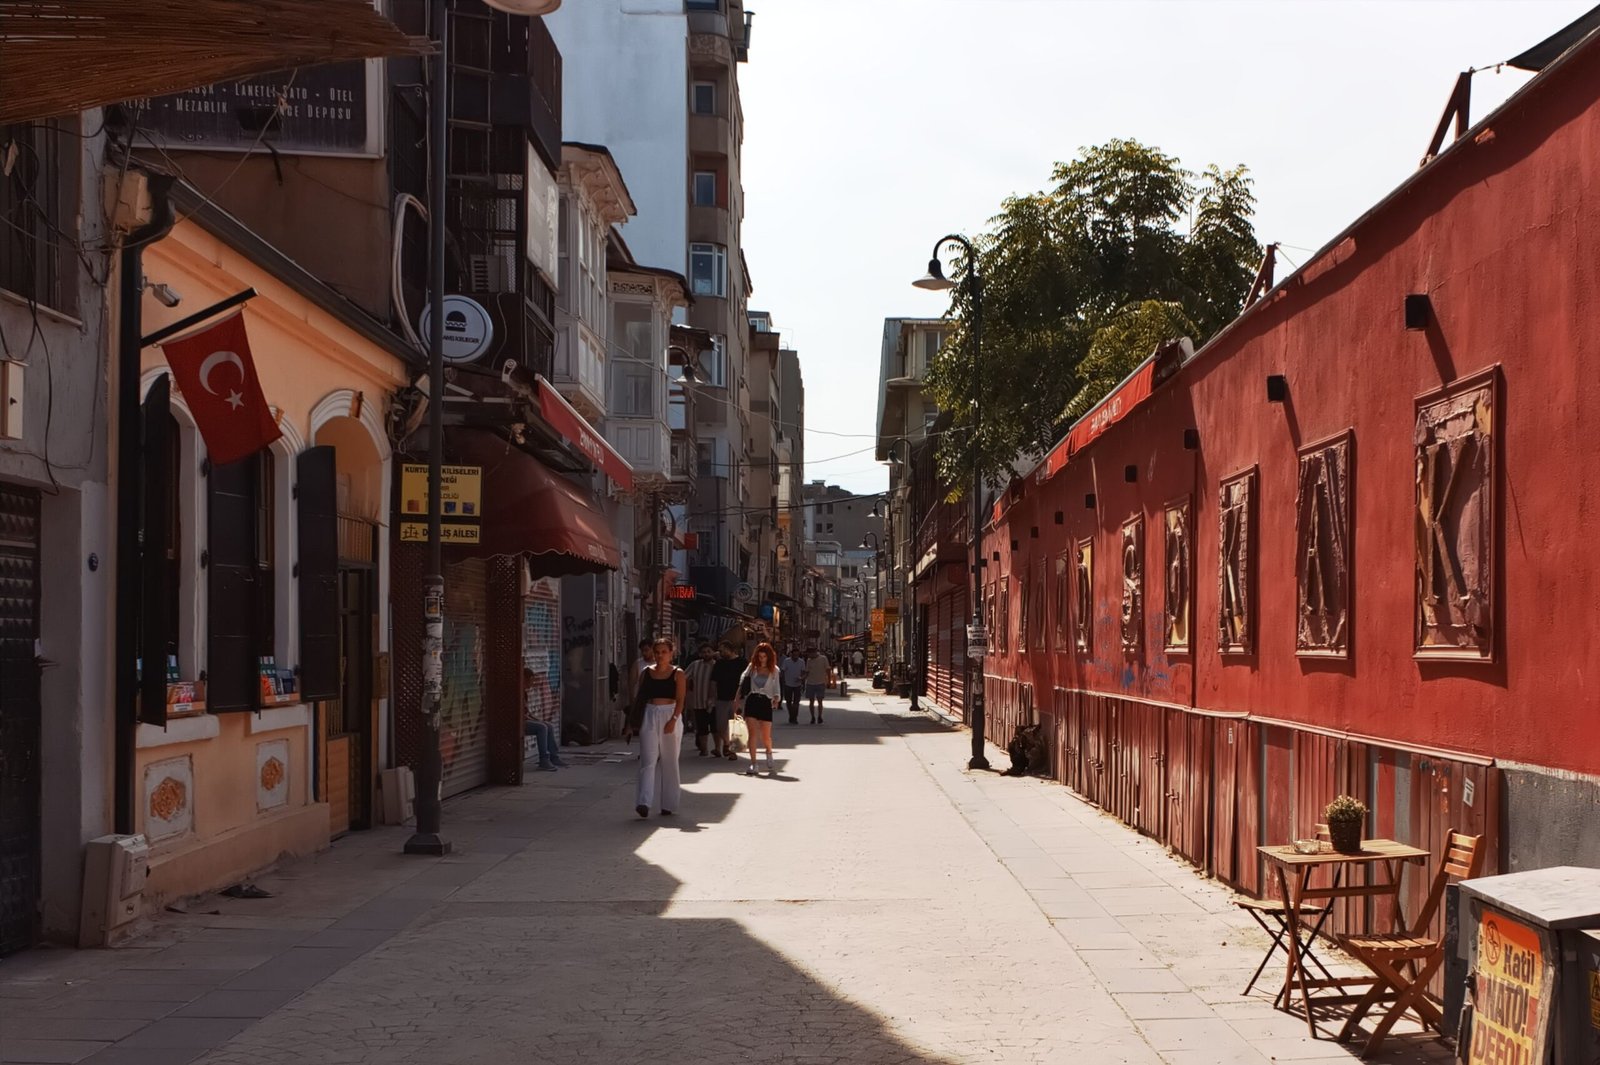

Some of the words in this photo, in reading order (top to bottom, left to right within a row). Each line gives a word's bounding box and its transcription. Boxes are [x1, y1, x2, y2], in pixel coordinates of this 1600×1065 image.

[176, 97, 228, 113] MEZARLIK
[307, 104, 351, 120] DEPOSU
[329, 87, 353, 102] OTEL
[1503, 943, 1536, 986] Katil
[1485, 975, 1530, 1037] NATO!
